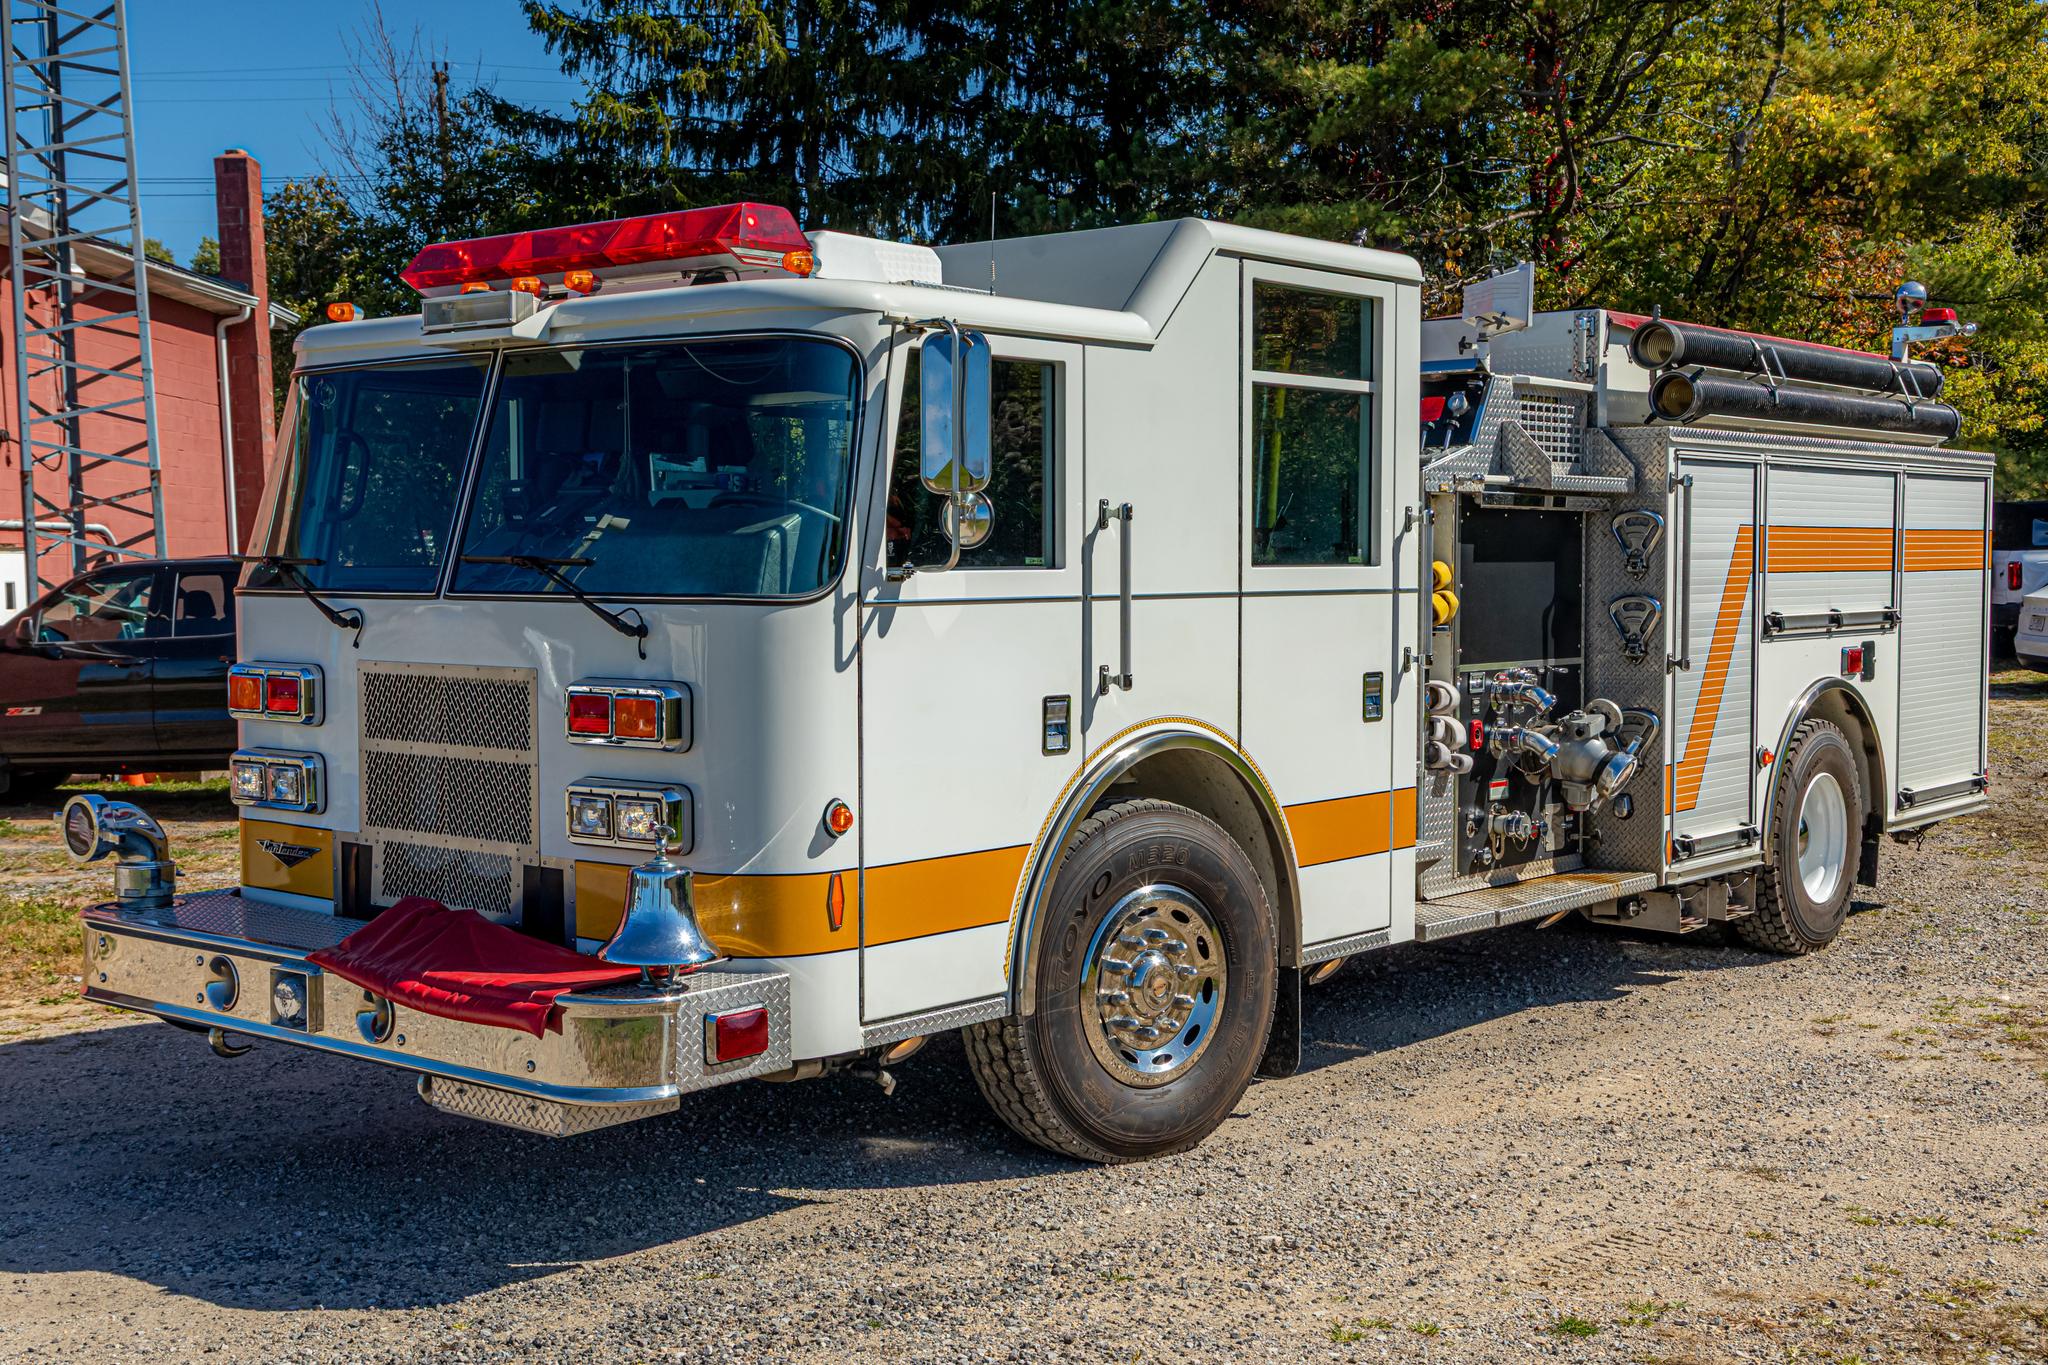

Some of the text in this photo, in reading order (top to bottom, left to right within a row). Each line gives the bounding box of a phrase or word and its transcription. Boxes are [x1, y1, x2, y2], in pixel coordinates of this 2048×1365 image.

[5, 706, 43, 716] Z71
[1127, 844, 1191, 872] M320
[1054, 870, 1113, 993] TOYO
